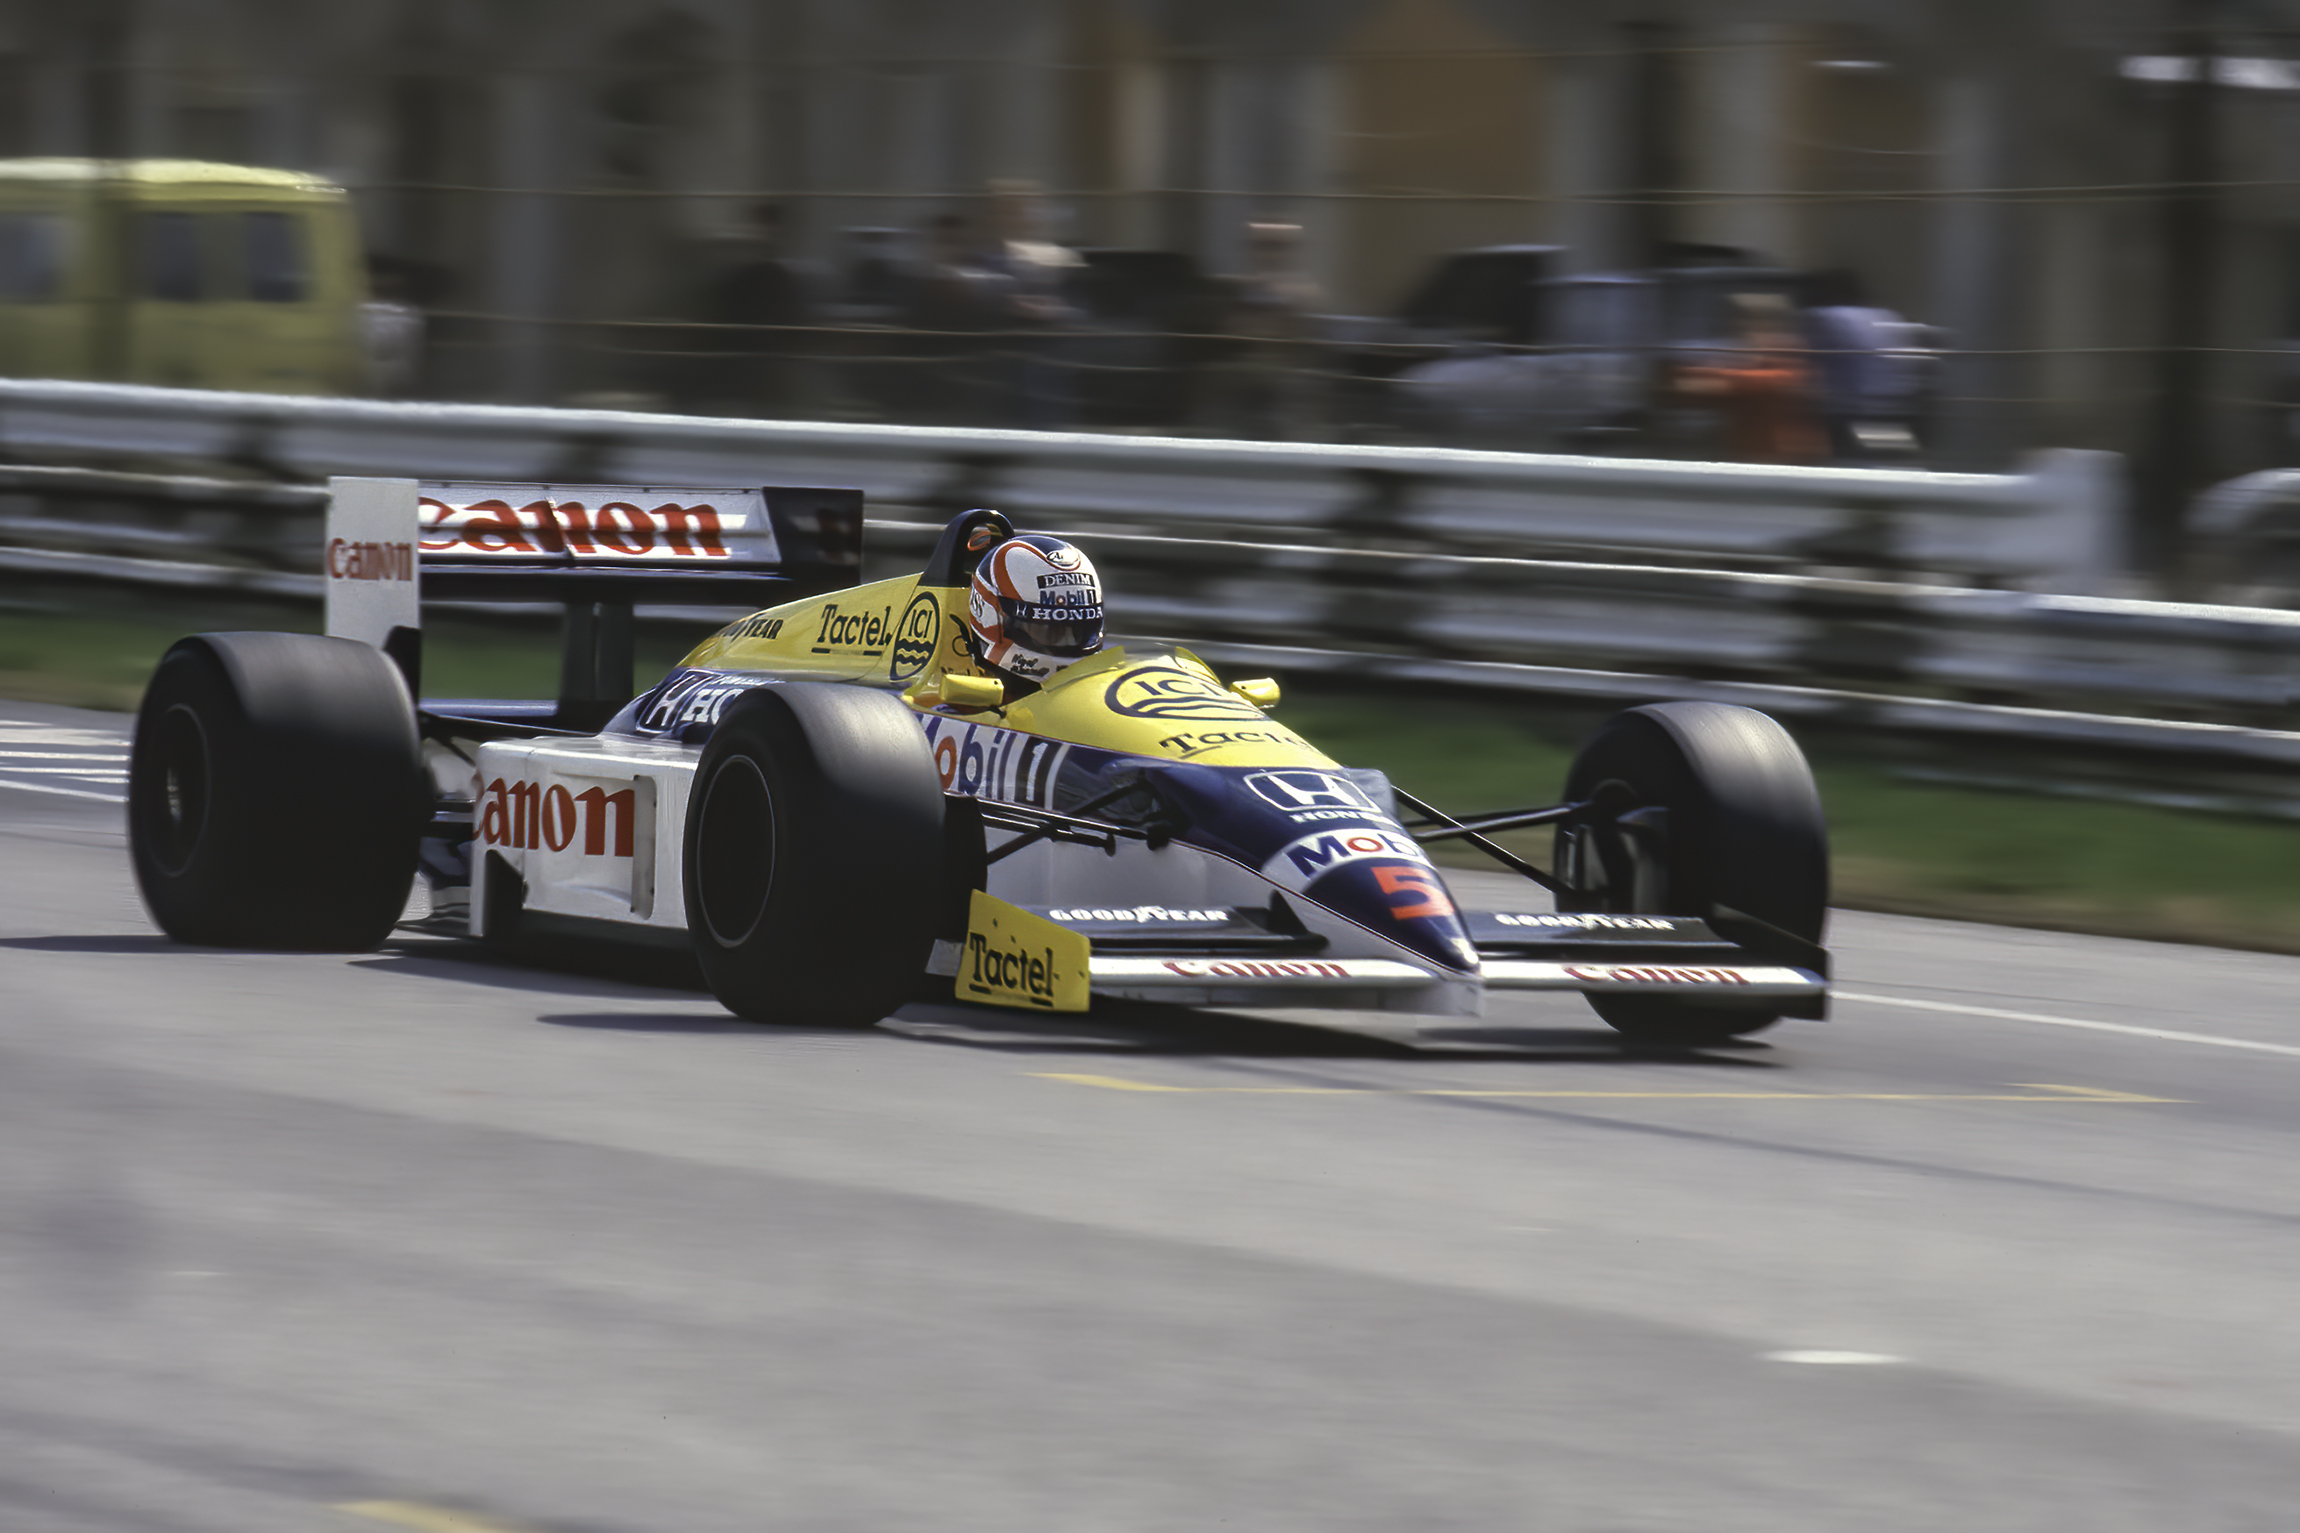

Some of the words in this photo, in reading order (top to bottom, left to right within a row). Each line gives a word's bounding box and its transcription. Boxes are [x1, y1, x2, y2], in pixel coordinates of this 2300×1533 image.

[1044, 573, 1090, 587] DENIM
[907, 609, 933, 638] ICI
[1032, 606, 1103, 620] HONDA
[1135, 680, 1222, 696] ICI
[1285, 834, 1418, 879] Mob
[1370, 866, 1454, 920] 5
[970, 932, 1053, 996] Tactel
